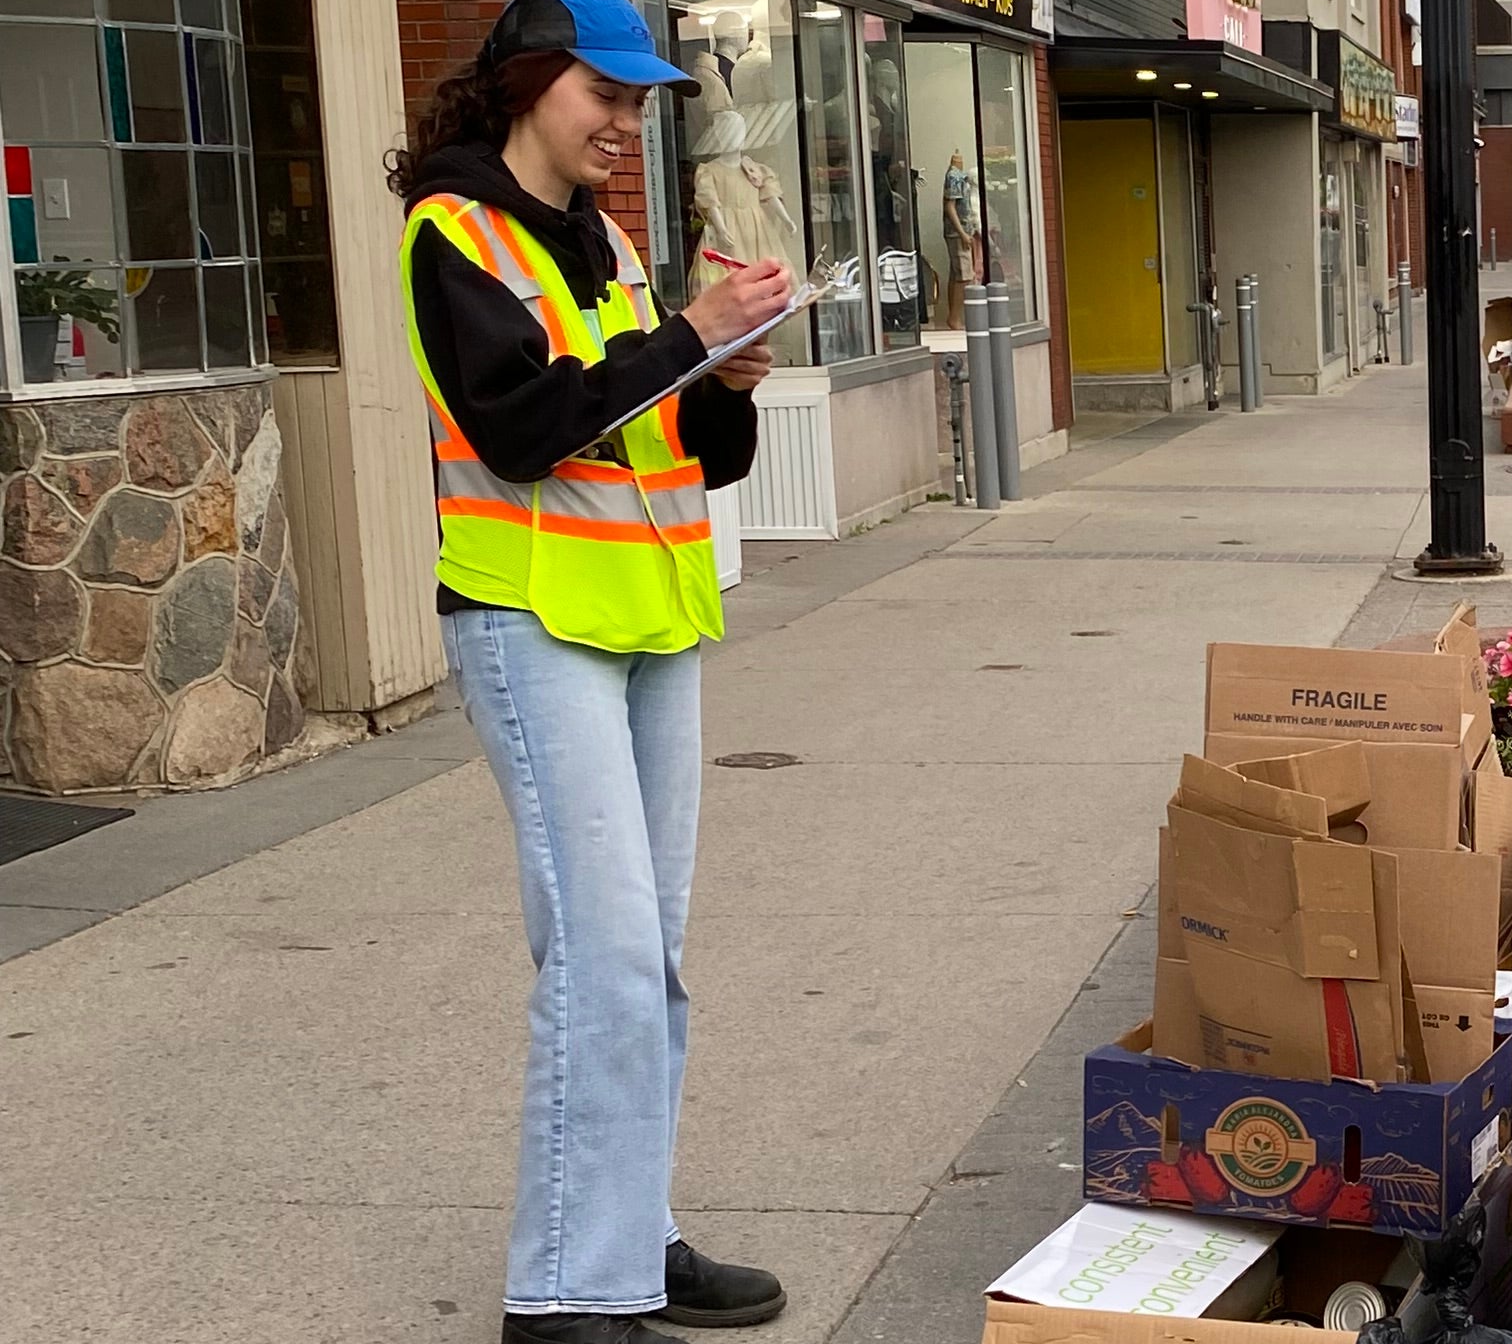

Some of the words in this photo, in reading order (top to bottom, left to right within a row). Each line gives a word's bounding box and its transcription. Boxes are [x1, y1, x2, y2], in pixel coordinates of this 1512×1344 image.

[1291, 689, 1387, 711] FRAGILE
[1233, 712, 1272, 724] HANDLE
[1275, 715, 1299, 726] WITH
[1301, 716, 1327, 727] CARE
[1334, 718, 1390, 731] MANIPULER
[1392, 721, 1418, 732] AVEC
[1420, 723, 1443, 733] SOIN
[1225, 1107, 1249, 1131] MARIA
[1251, 1106, 1299, 1138] ALEJANDRA
[1234, 1168, 1285, 1188] TOMATOES
[1059, 1222, 1173, 1304] consistent
